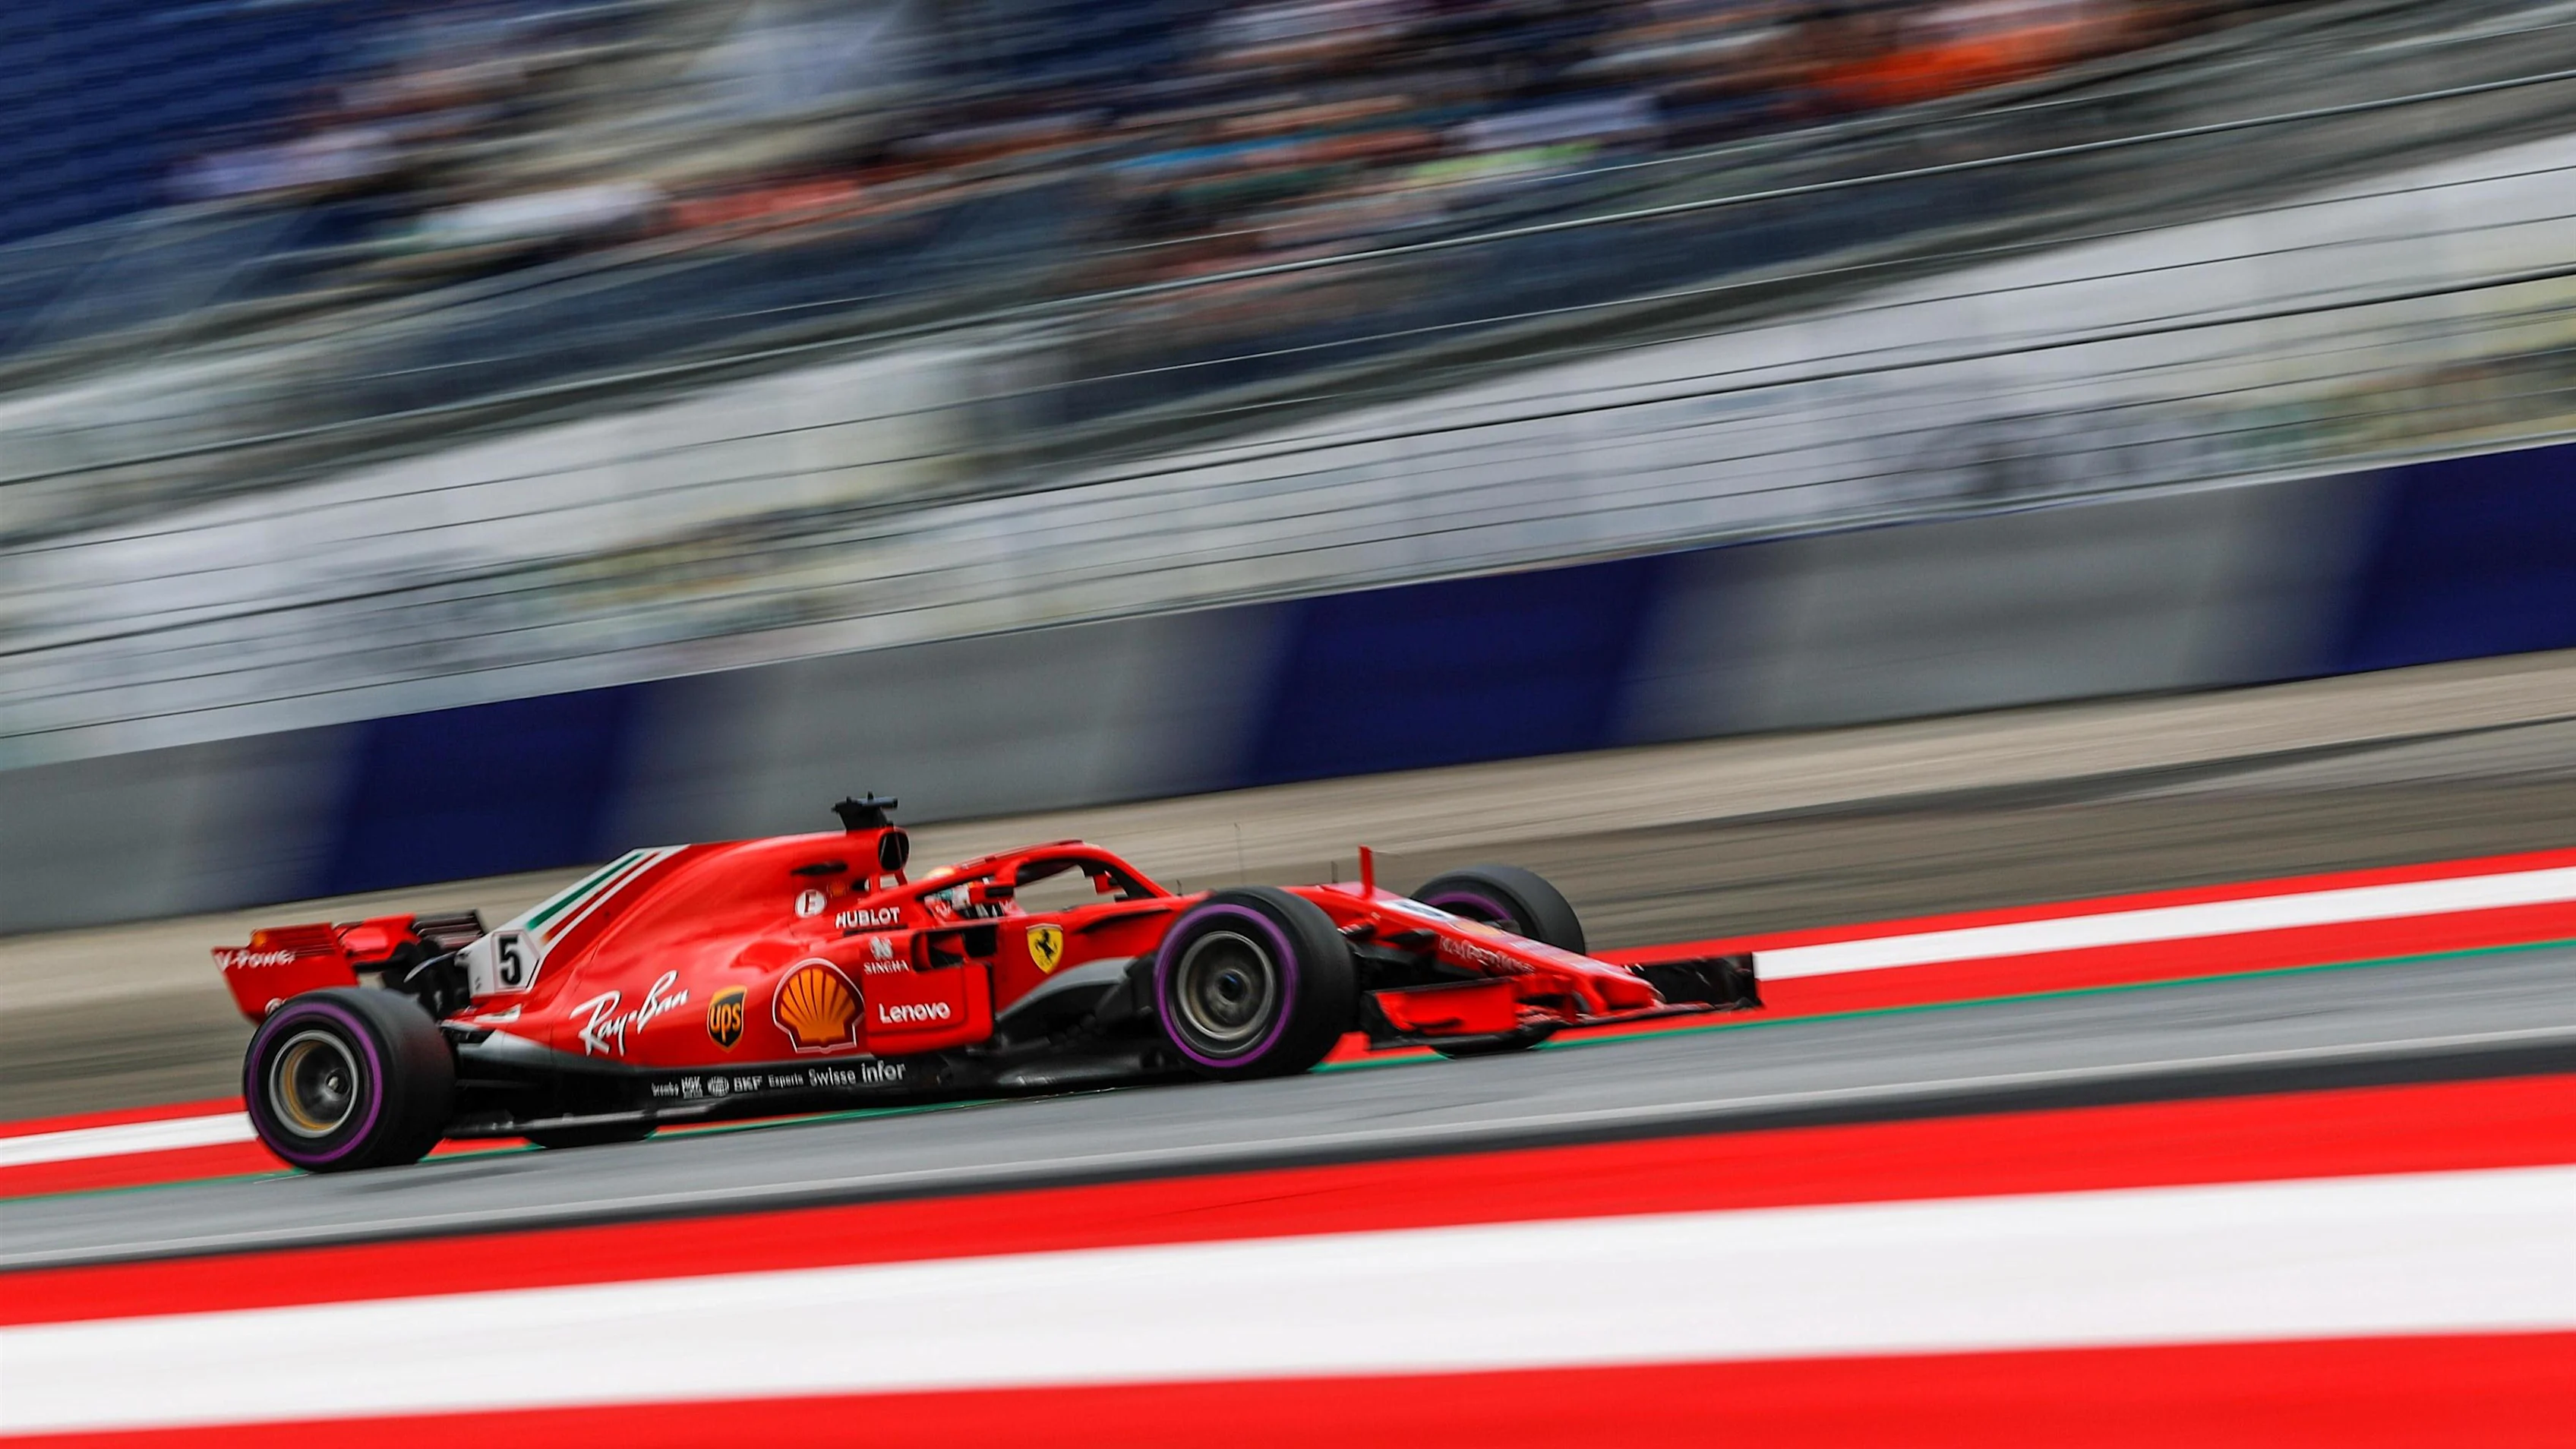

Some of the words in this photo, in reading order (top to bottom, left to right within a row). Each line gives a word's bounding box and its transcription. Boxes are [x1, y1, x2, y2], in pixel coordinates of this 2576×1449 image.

[835, 907, 901, 929] HUBLOT
[214, 949, 296, 972] V-Power
[498, 935, 522, 986] 5
[863, 959, 910, 975] SINGHA
[570, 970, 690, 1056] Ray-Ban
[709, 1002, 741, 1043] ups
[879, 1002, 951, 1024] Lenovo
[808, 1067, 857, 1087] Swisse
[861, 1060, 906, 1084] infor
